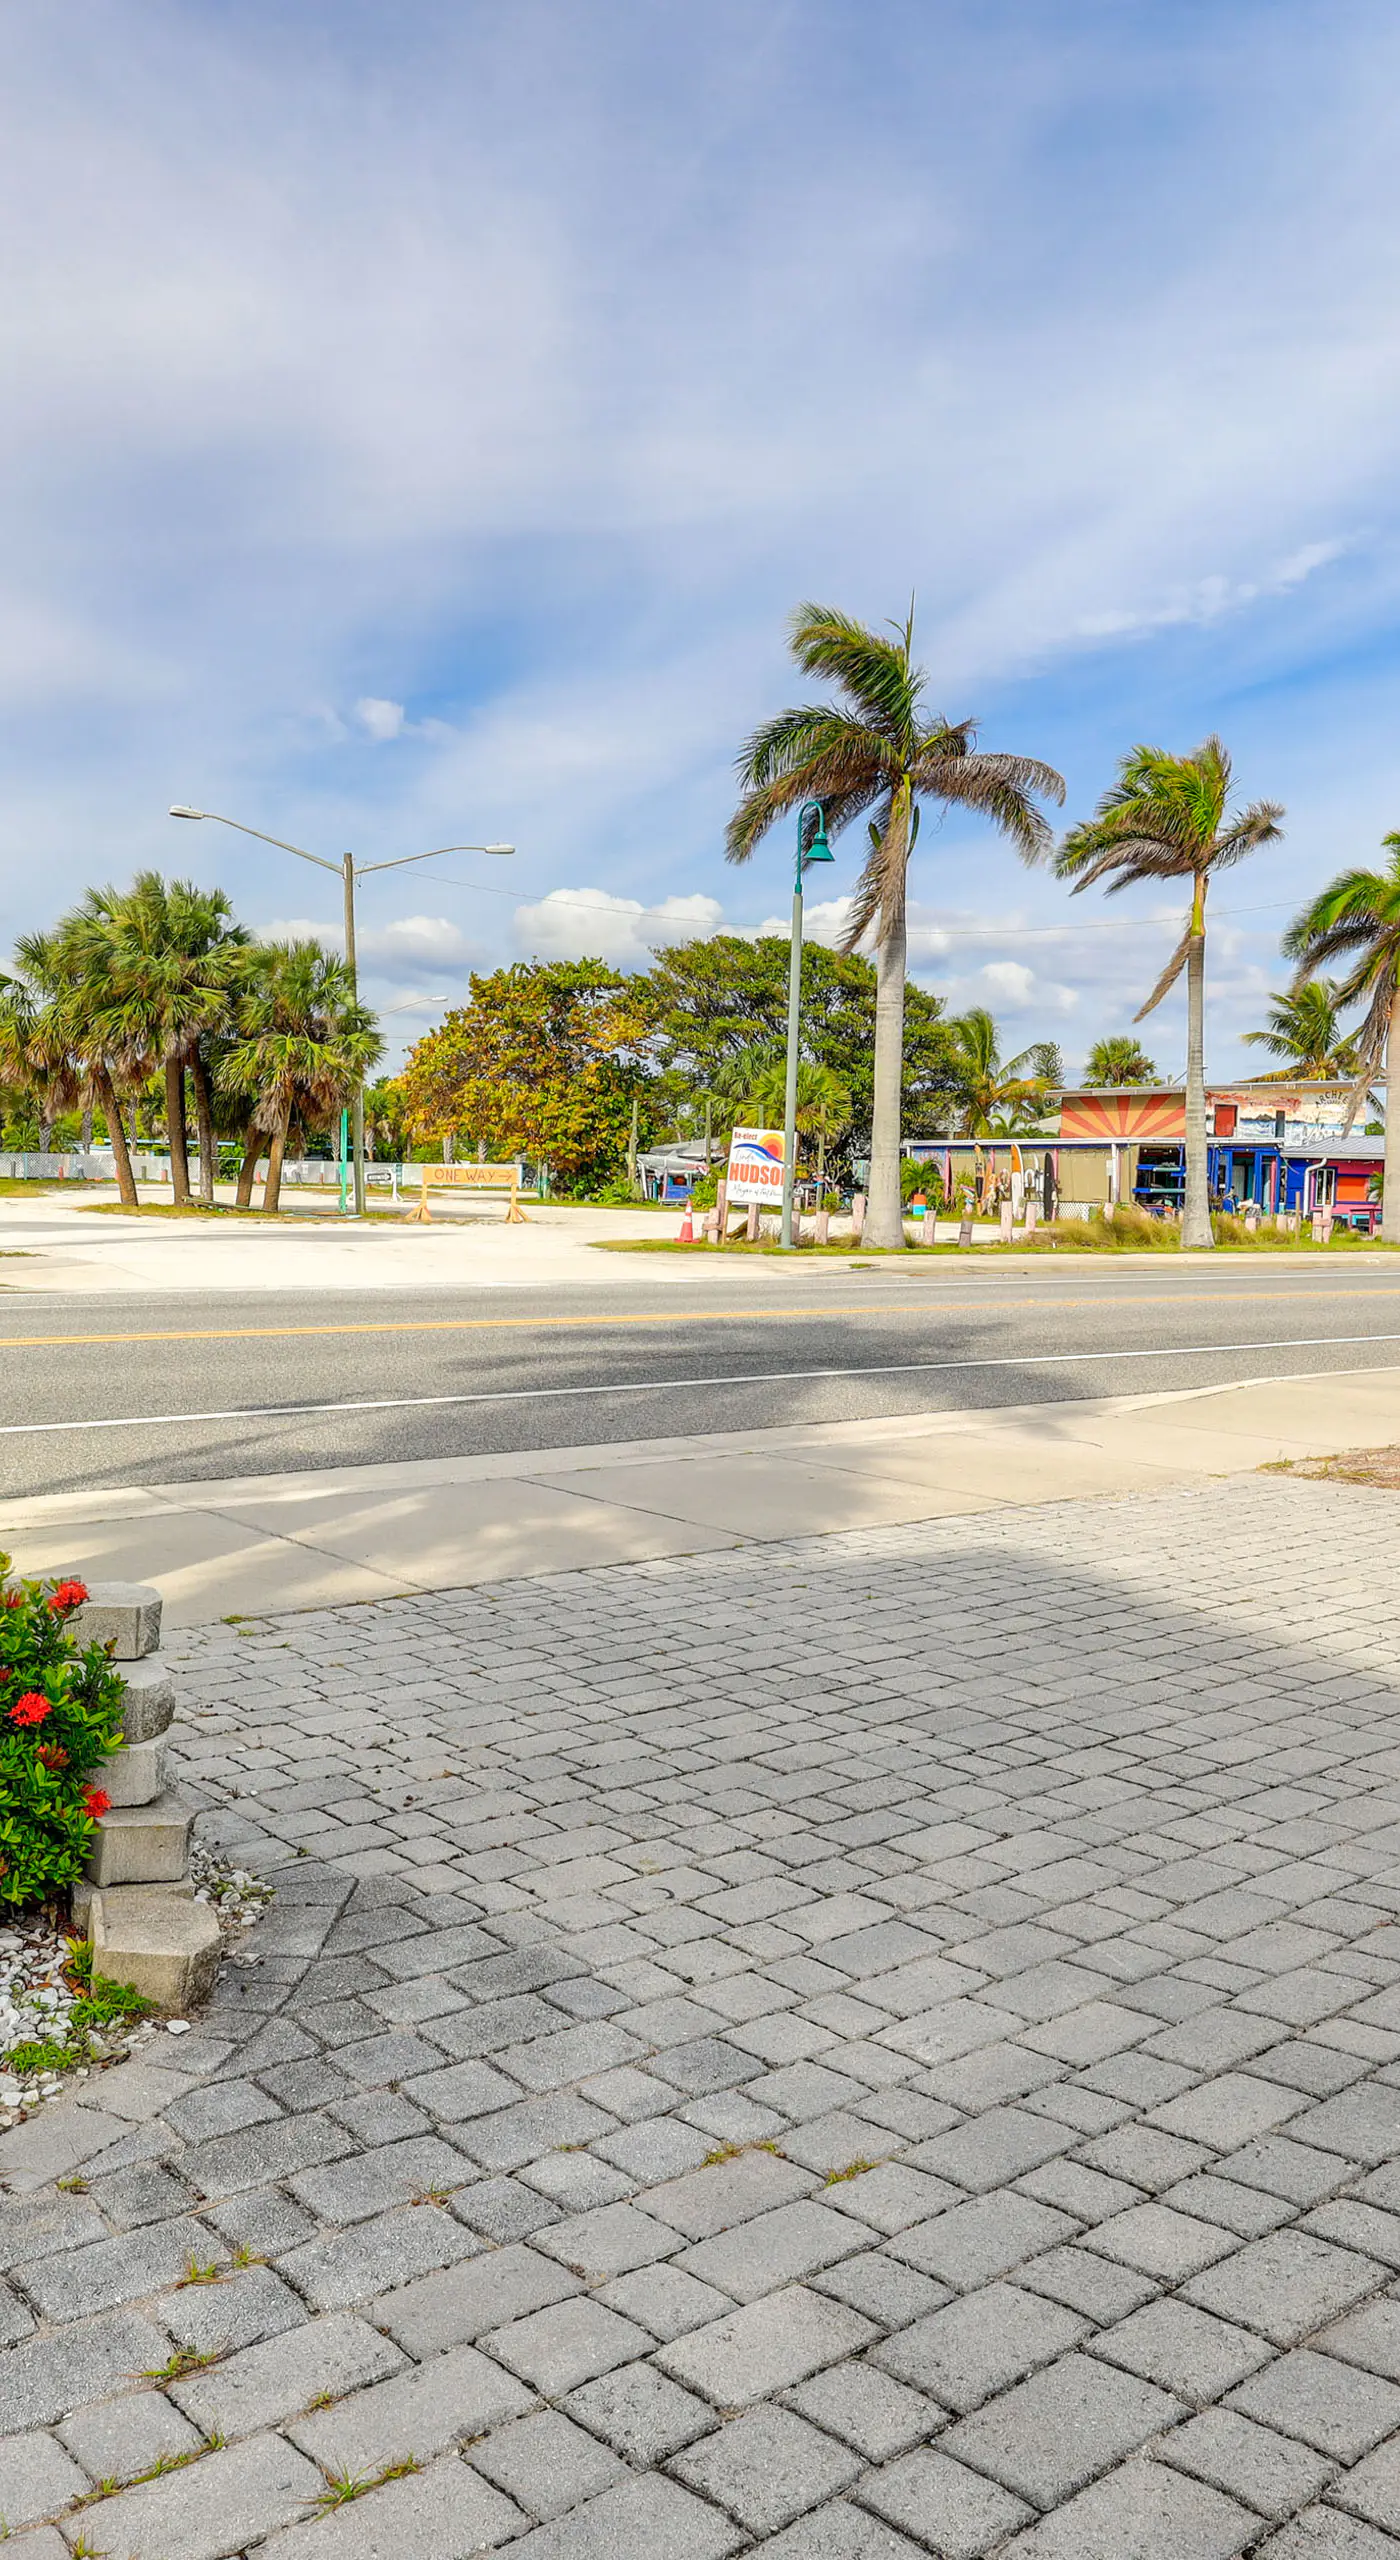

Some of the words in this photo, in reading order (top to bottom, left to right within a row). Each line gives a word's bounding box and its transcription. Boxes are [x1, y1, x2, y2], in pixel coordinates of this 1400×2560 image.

[734, 1132, 757, 1140] Re-elect
[434, 1168, 462, 1181] ONE
[465, 1169, 495, 1183] WAY
